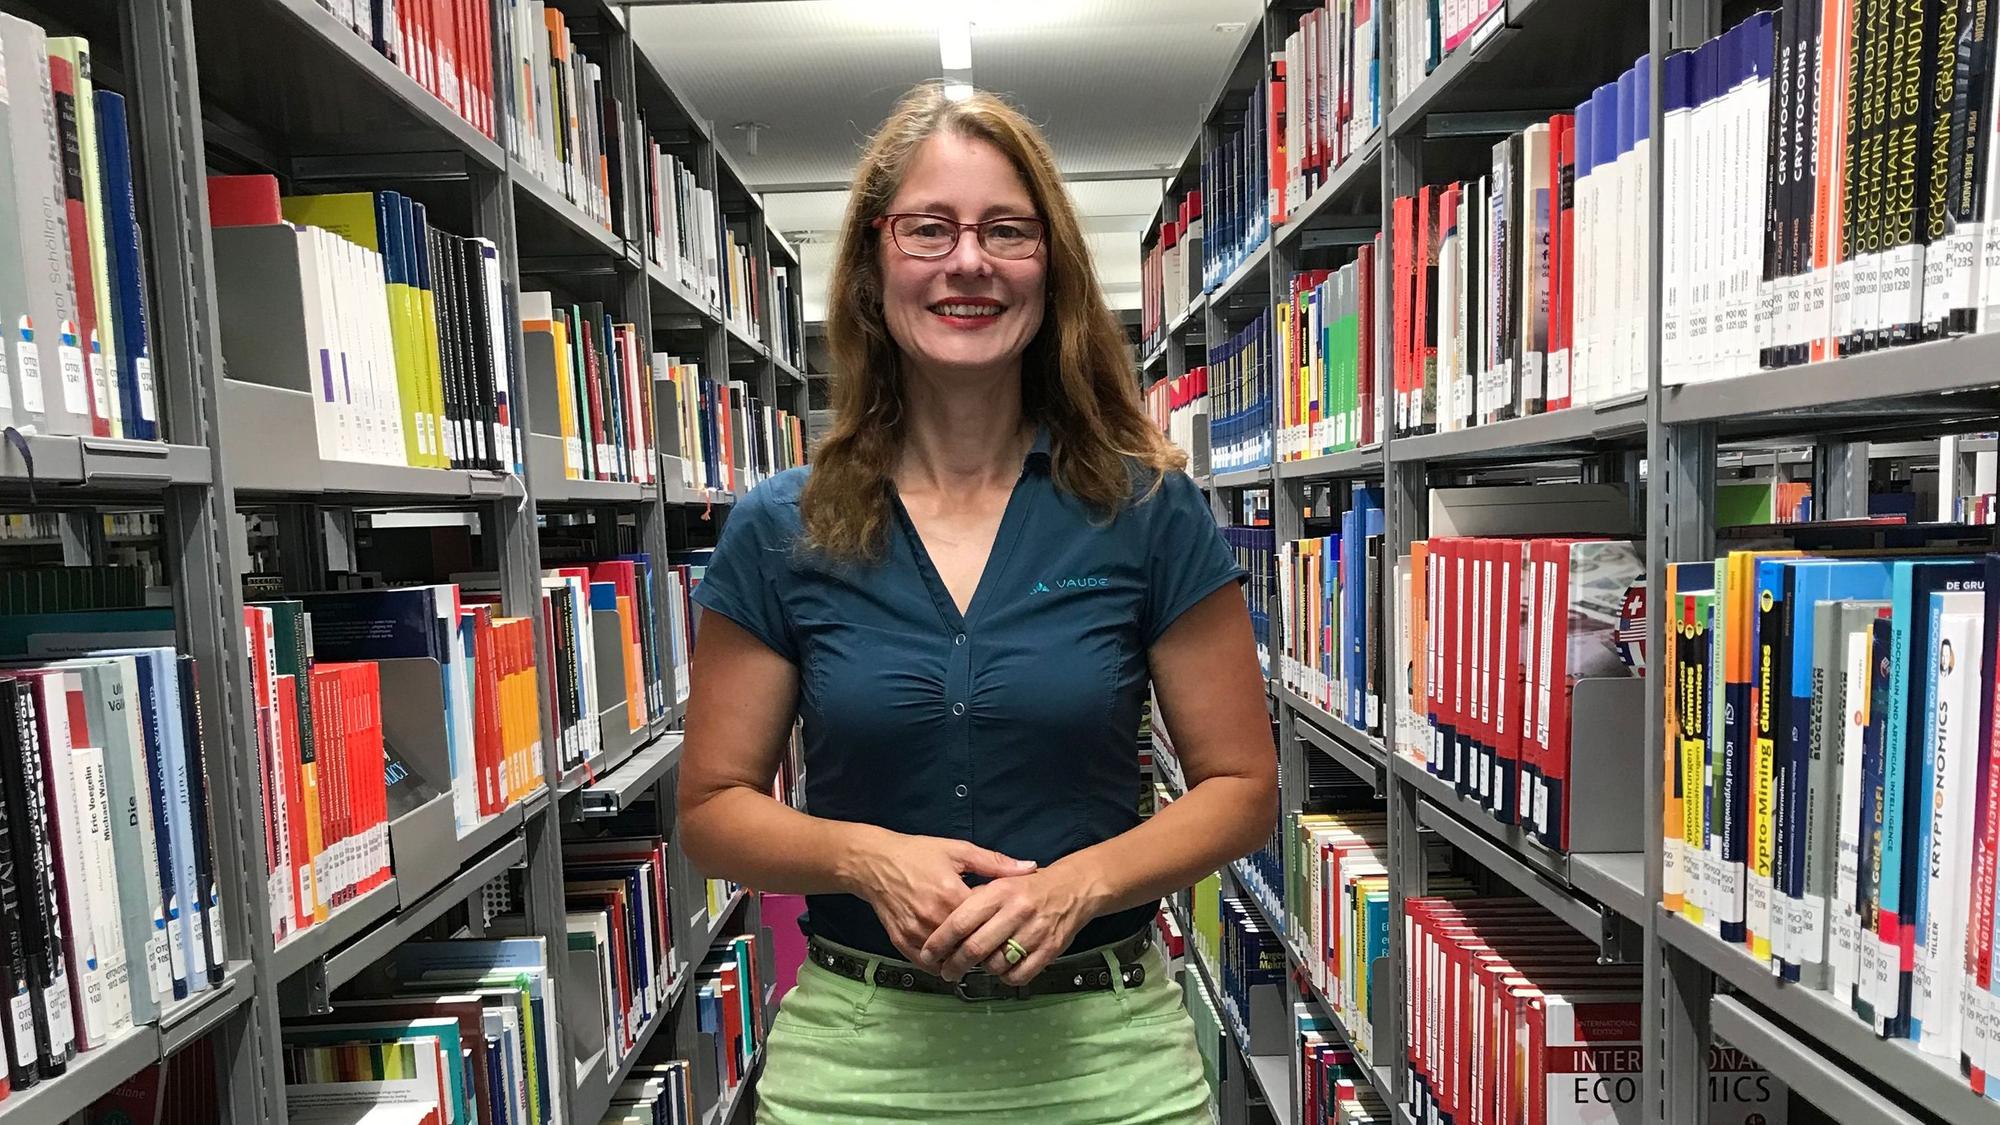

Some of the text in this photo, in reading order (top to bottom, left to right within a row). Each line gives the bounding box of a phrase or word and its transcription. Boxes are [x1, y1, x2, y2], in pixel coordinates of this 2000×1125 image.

[1941, 0, 1959, 103] GRUNDL
[1779, 46, 1791, 186] CRYPTOCOINS
[1794, 40, 1807, 182] CRYPTOCOINS
[1856, 0, 1878, 254] OCKCHAIN GRUNDLAG
[1868, 0, 1890, 251] OCKCHAIN GRUNDLAG
[1897, 0, 1924, 245] OCKCHAIN GRUNDLA
[1841, 144, 1855, 257] OCKCHAIN
[1884, 129, 1900, 247] OCKCHAIN
[1933, 112, 1952, 236] OCKCHAIN
[43, 195, 63, 285] Schöllgen
[1894, 266, 1910, 278] PQQ
[1954, 241, 1974, 252] PQQ
[1954, 256, 1974, 267] 1235
[1894, 280, 1911, 291] 1230
[1056, 578, 1110, 588] VAUDE
[1946, 581, 1985, 591] DE GRU
[1686, 666, 1695, 737] dummies
[1695, 663, 1703, 734] dummies
[1760, 644, 1771, 733] dummies
[1894, 629, 1902, 696] BLOCKCHAIN
[20, 694, 34, 784] JOHNSTON
[269, 648, 279, 715] POLITIK
[281, 801, 291, 868] VERSTE
[1814, 667, 1824, 761] BLOCKCHAIN
[1890, 724, 1898, 778] ARTIFICIAL
[27, 692, 62, 940] AKTE TRUMP
[84, 765, 99, 834] Eric Voegelin
[97, 763, 111, 842] Michael Walzer
[128, 795, 139, 827] Die
[384, 761, 408, 786] OLICY
[1723, 741, 1734, 860] ICO und Kryptowährungen
[1758, 743, 1772, 878] rypto-Mining
[1887, 780, 1896, 853] INTELLIGENCE
[1931, 700, 1948, 880] KRYPTONOMICS
[1986, 763, 1999, 844] FINANCIAL
[1872, 845, 1881, 883] Geld
[1981, 849, 1994, 951] INFORMATION
[9, 930, 21, 975] NEVER
